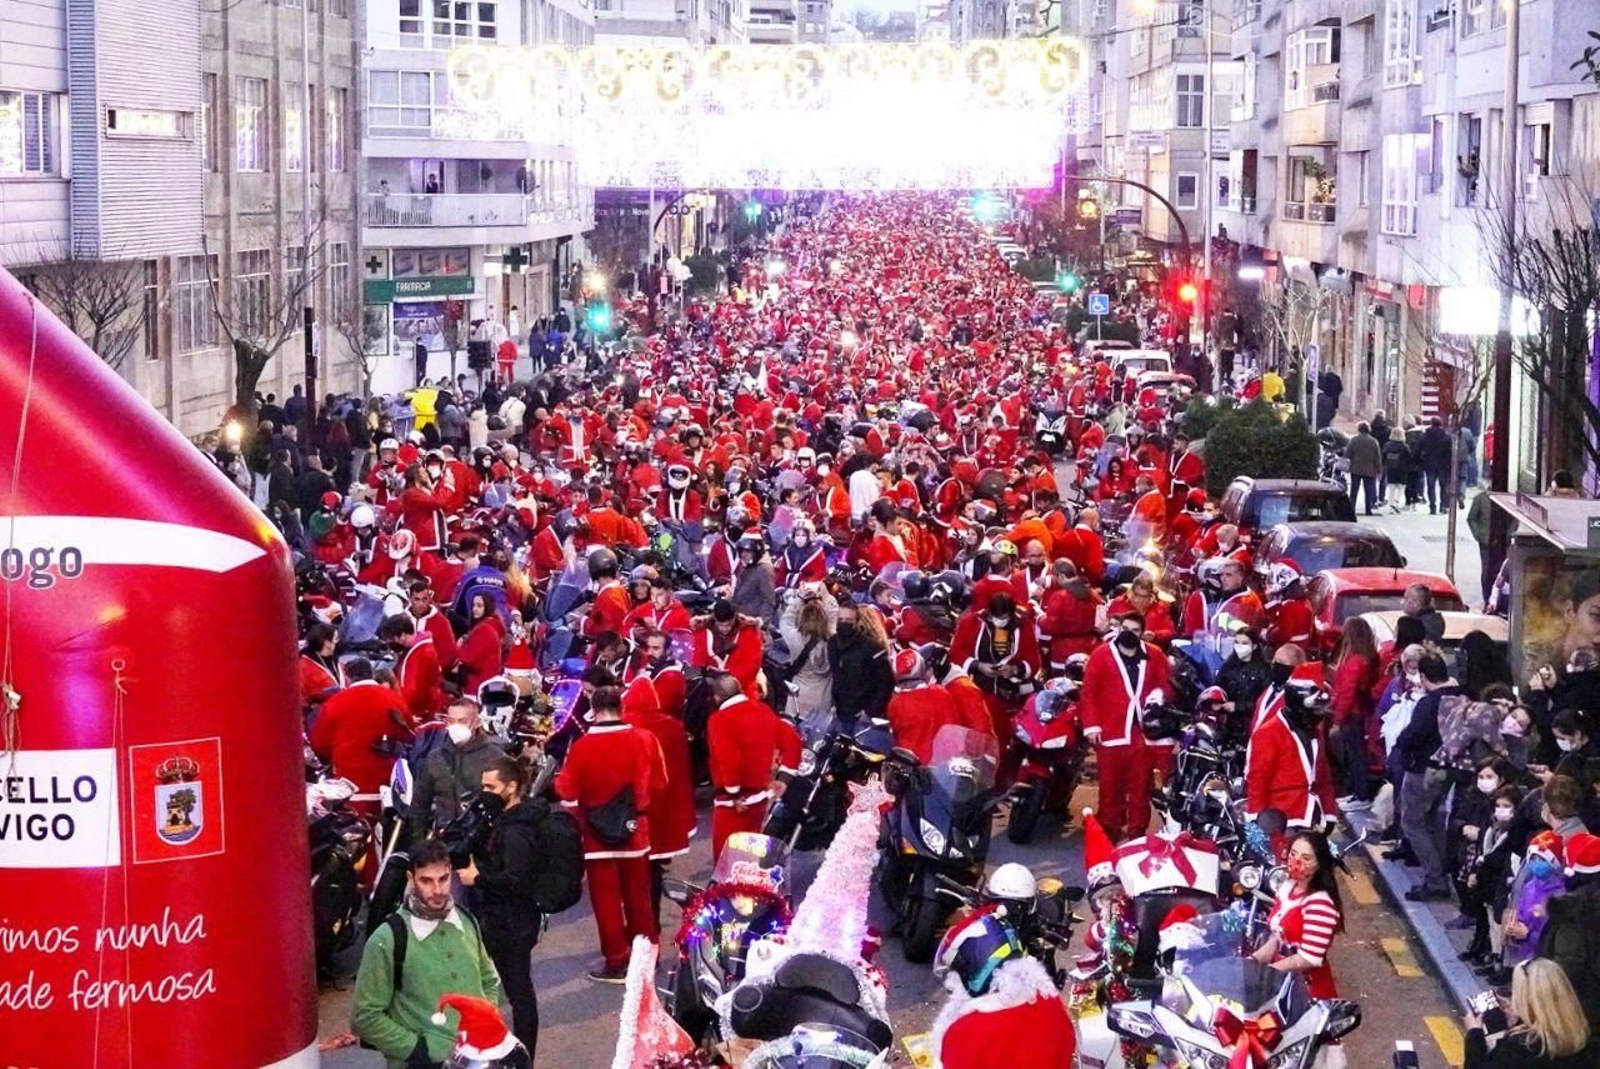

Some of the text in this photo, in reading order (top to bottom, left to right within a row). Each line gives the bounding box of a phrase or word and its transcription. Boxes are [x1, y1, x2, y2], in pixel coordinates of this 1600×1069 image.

[396, 281, 431, 292] FARMACIA
[0, 775, 97, 804] ELLO
[95, 906, 206, 952] nunha
[68, 968, 216, 1011] fermosa
